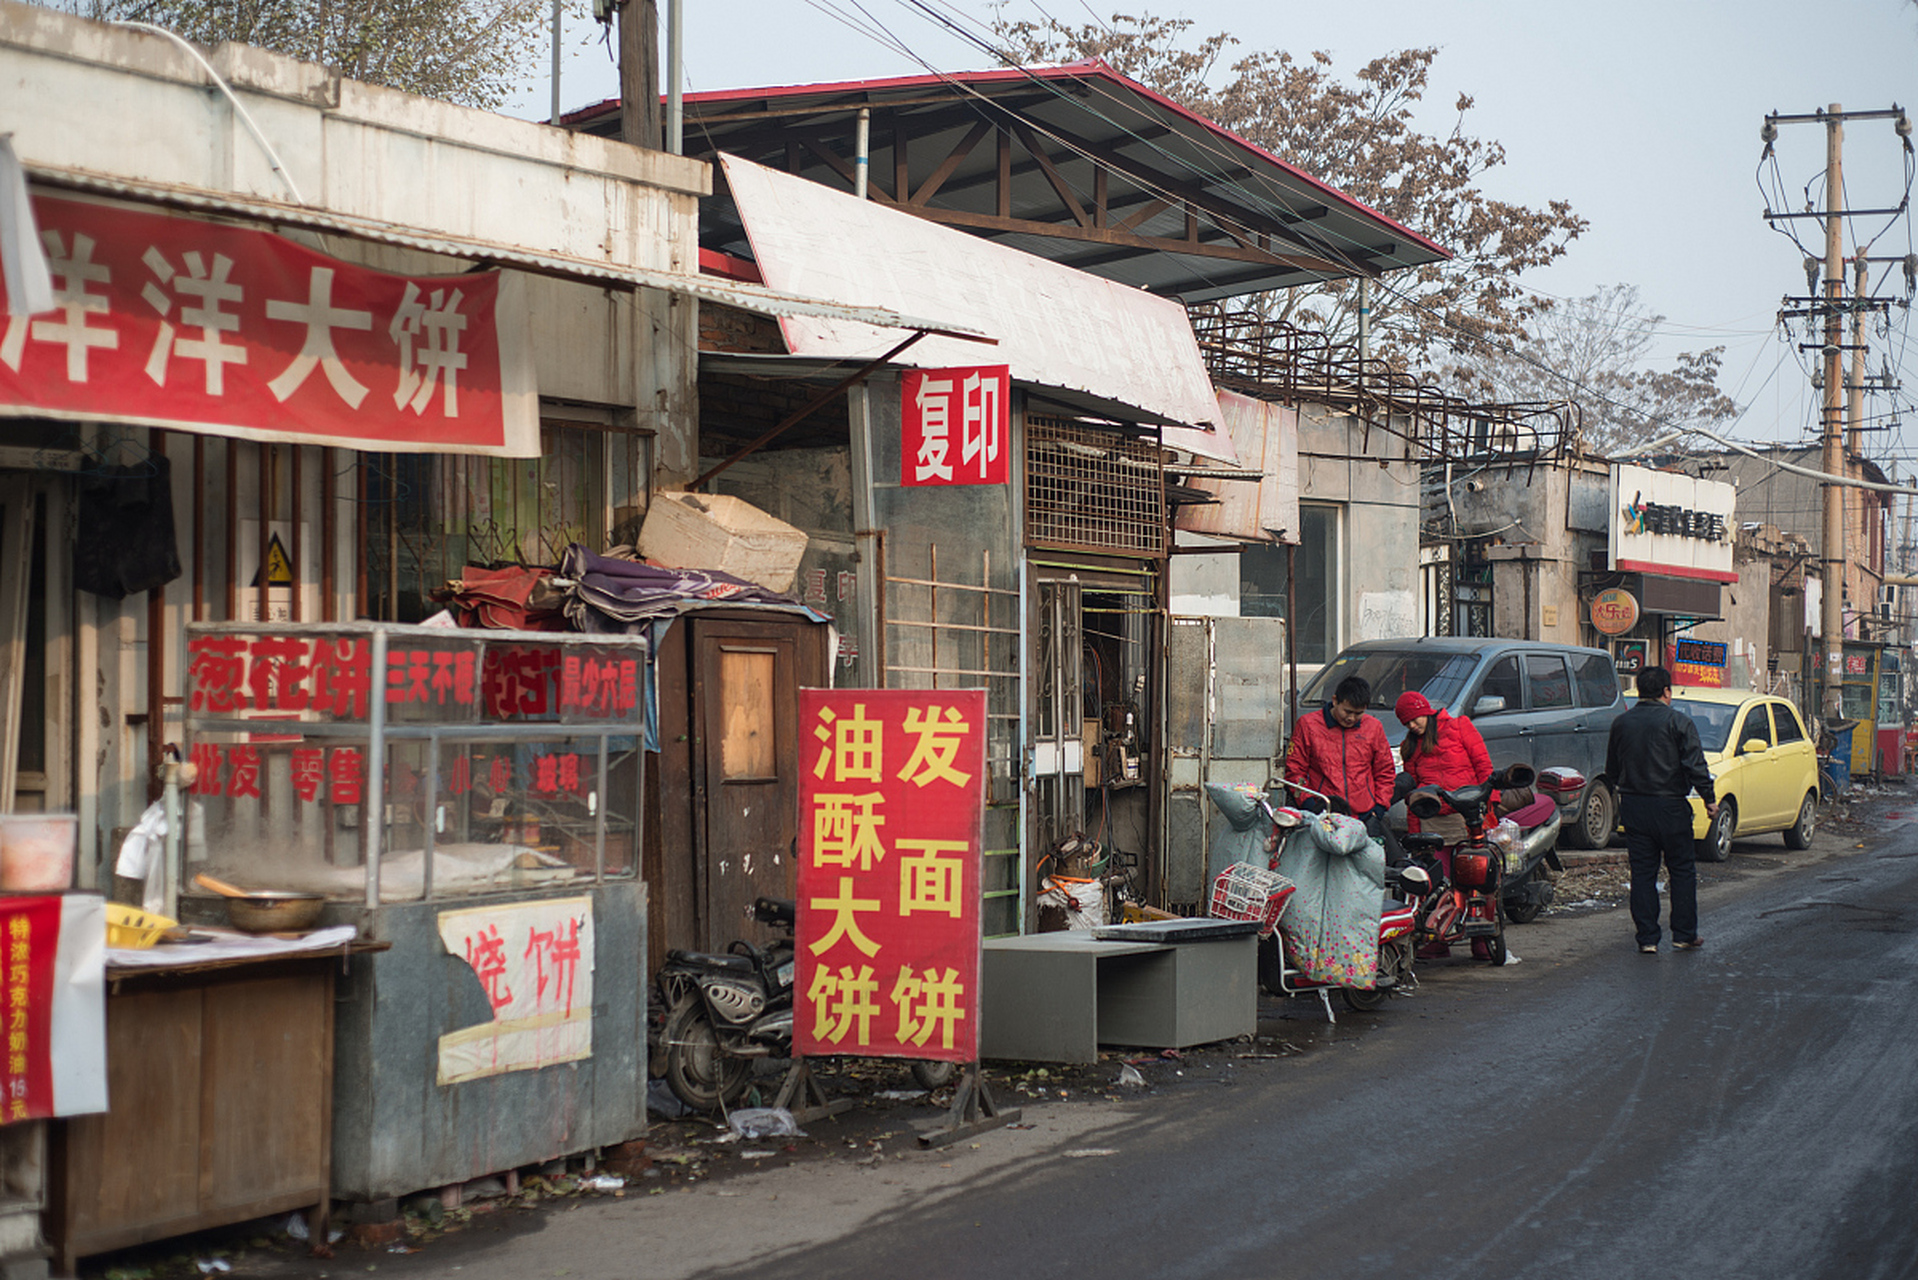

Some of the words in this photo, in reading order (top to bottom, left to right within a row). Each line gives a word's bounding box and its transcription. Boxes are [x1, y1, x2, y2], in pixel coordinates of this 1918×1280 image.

[0, 229, 468, 418] 洋洋大饼
[915, 370, 998, 481] 复印
[804, 568, 857, 605] 复印
[189, 636, 372, 718] 葱花饼
[189, 743, 261, 799] 批发
[290, 748, 362, 804] 零售
[807, 704, 886, 1046] 油酥大饼
[890, 705, 973, 1050] 发面饼
